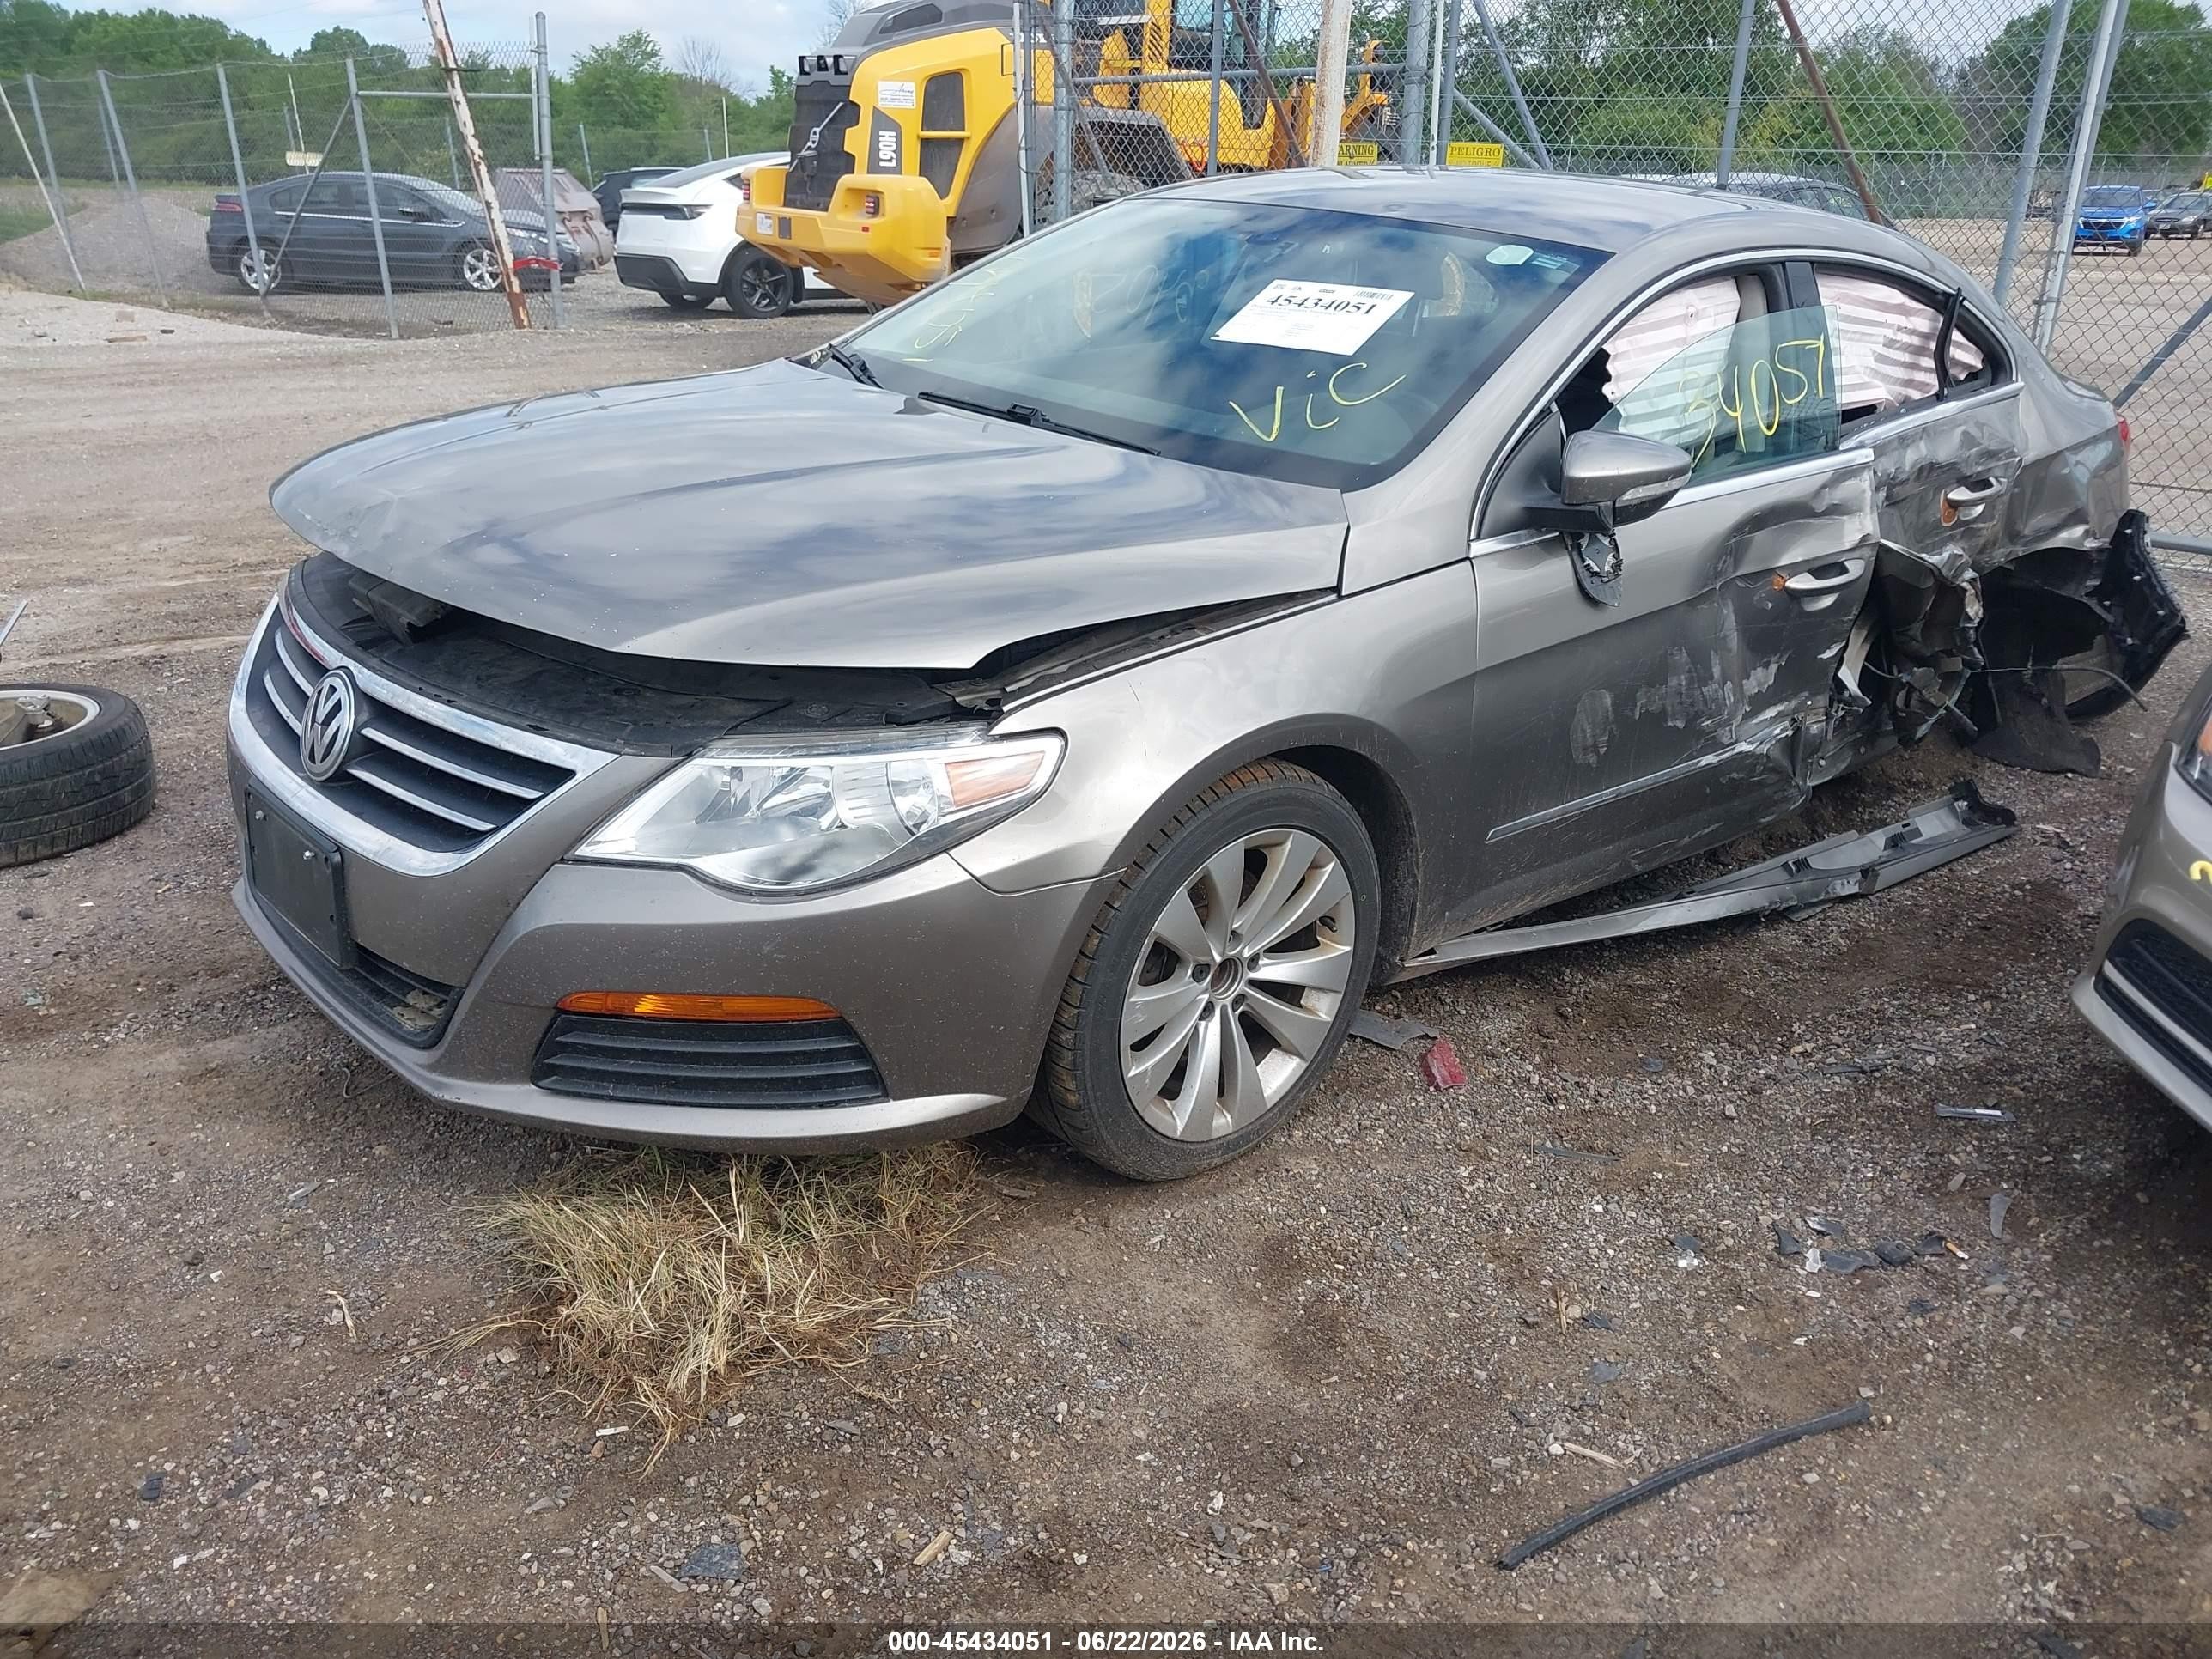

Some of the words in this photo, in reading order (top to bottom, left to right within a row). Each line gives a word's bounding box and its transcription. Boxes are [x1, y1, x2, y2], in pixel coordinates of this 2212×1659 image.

[878, 131, 897, 167] L90H
[1338, 144, 1374, 155] ARNING
[1450, 146, 1501, 157] PELIGRO
[1266, 294, 1377, 315] 45434051
[302, 673, 353, 776] VW
